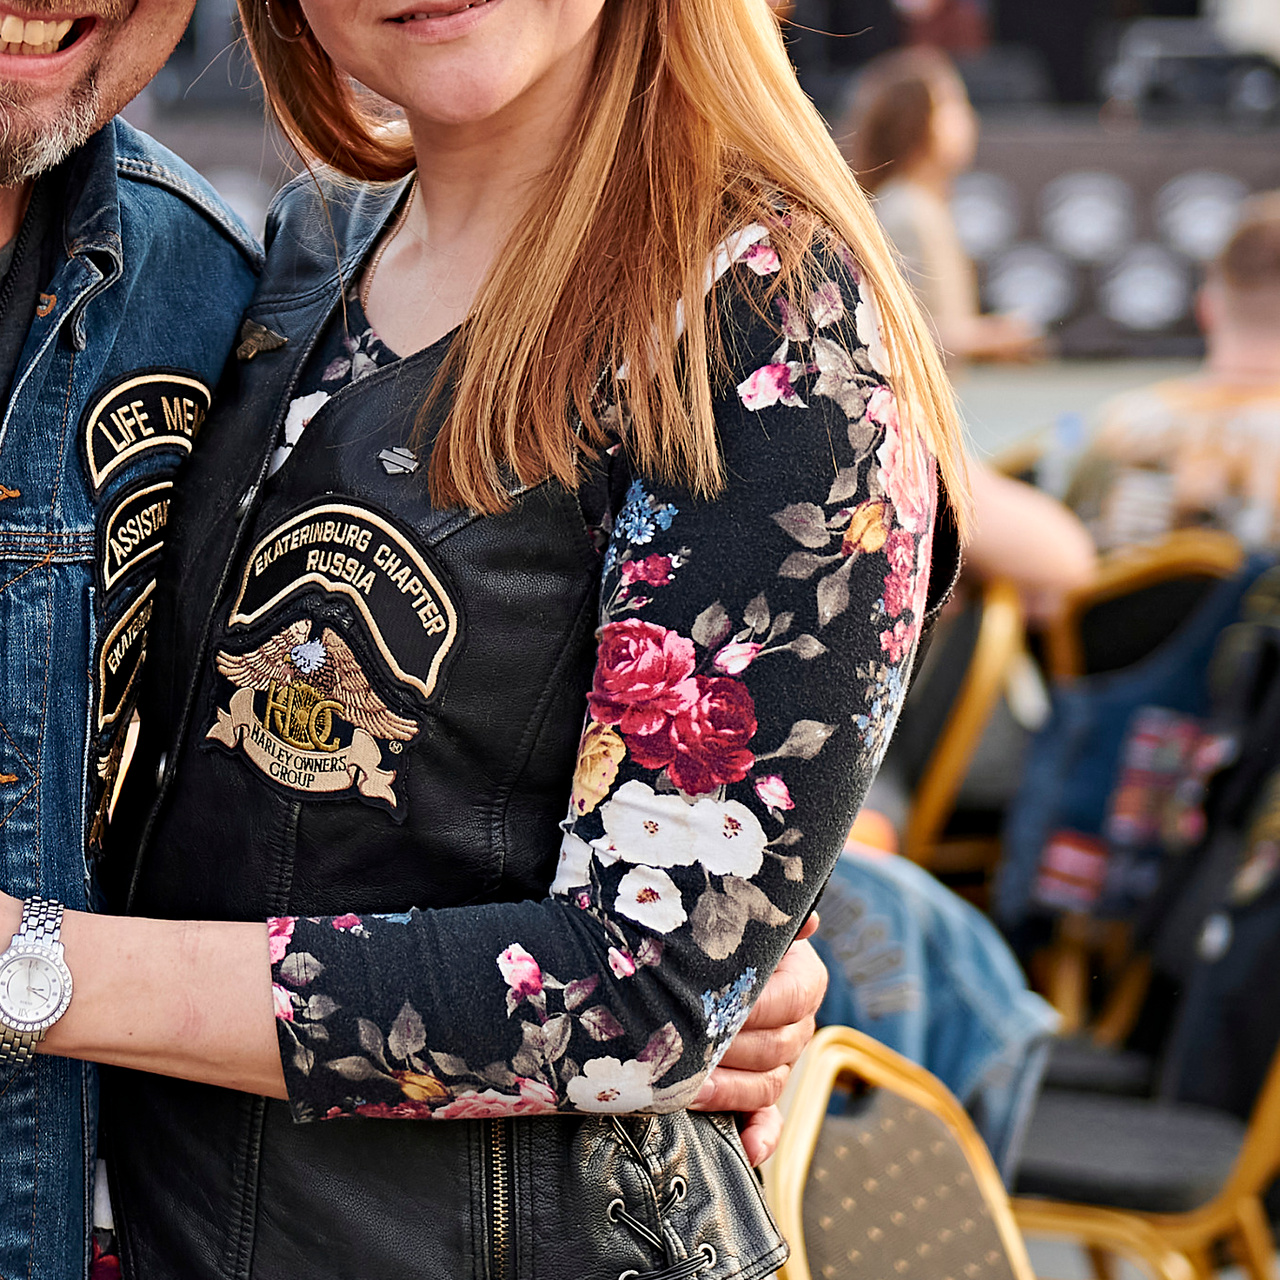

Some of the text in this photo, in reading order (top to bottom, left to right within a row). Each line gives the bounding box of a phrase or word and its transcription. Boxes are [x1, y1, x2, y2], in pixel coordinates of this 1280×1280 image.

[97, 400, 155, 453] LIFE
[255, 521, 447, 637] EKATERINBURG CHAPTER
[305, 549, 377, 595] RUSSIA
[251, 723, 348, 773] HARLEY OWNERS
[269, 761, 316, 788] GROUP
